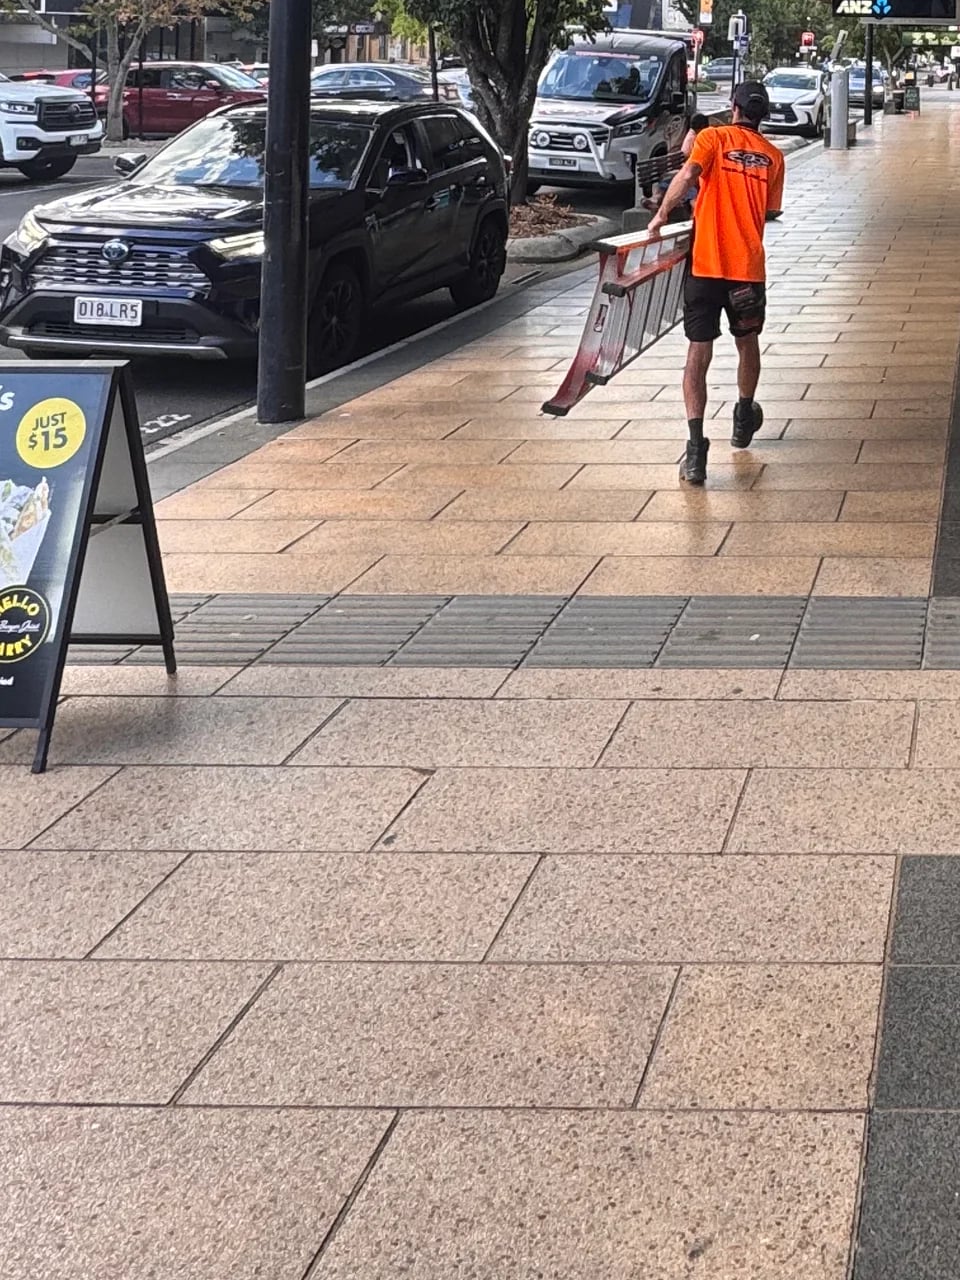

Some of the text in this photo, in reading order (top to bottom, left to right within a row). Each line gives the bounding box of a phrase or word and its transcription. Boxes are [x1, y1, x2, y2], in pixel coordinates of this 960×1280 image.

[836, 0, 873, 15] ANZ
[32, 411, 66, 433] JUST
[28, 427, 68, 452] $15
[0, 593, 40, 617] ELLO
